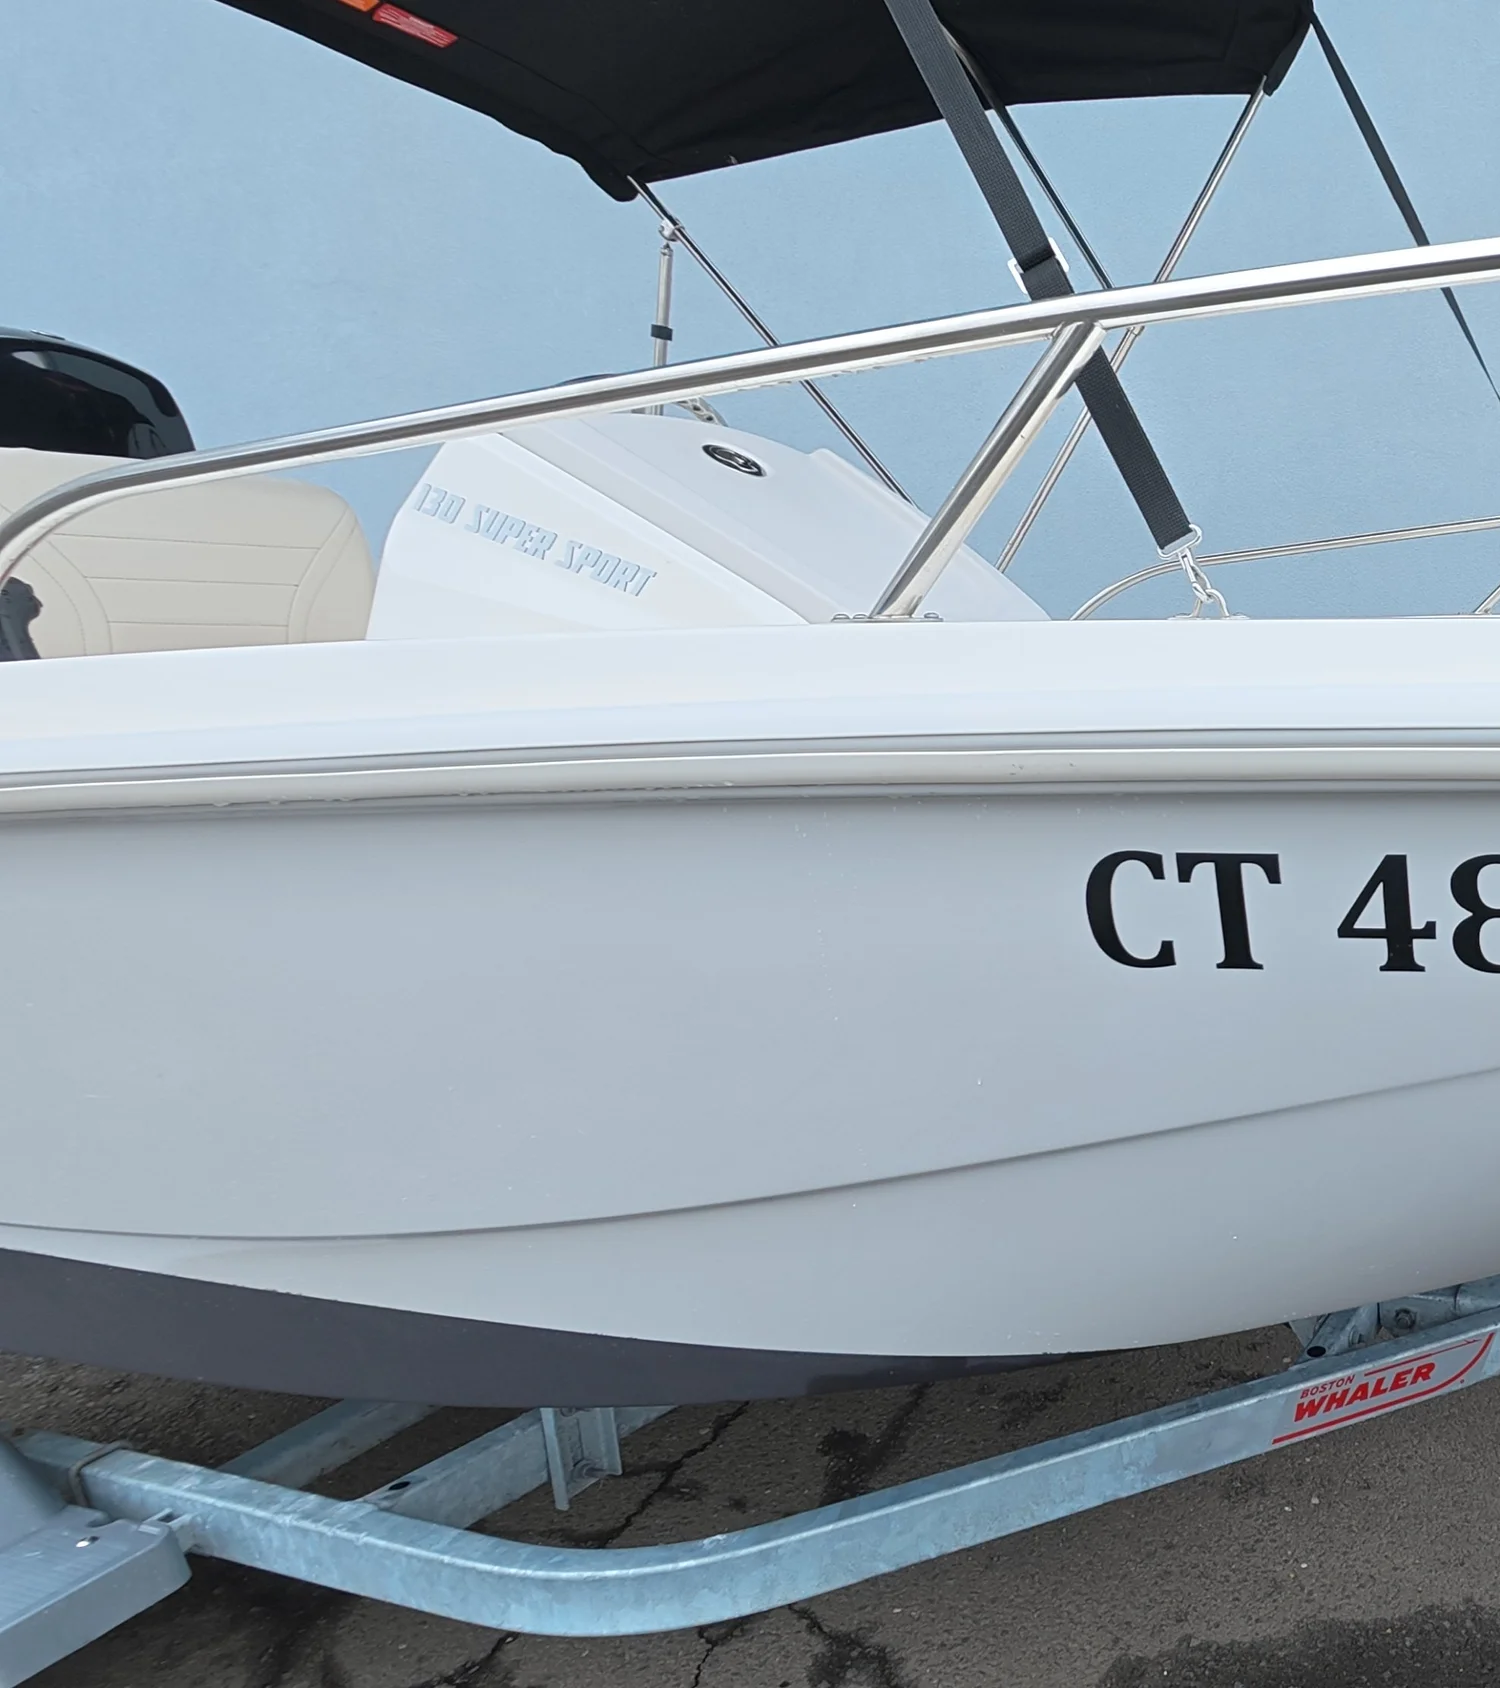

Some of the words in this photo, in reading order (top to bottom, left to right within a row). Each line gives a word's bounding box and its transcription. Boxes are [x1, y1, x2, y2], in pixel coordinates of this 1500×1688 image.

[415, 484, 465, 524] 130
[464, 504, 557, 560] SUPER
[555, 540, 657, 597] SPORT
[1086, 851, 1281, 969] CT
[1294, 1362, 1435, 1422] WHALER
[1301, 1375, 1355, 1399] BOSTON
